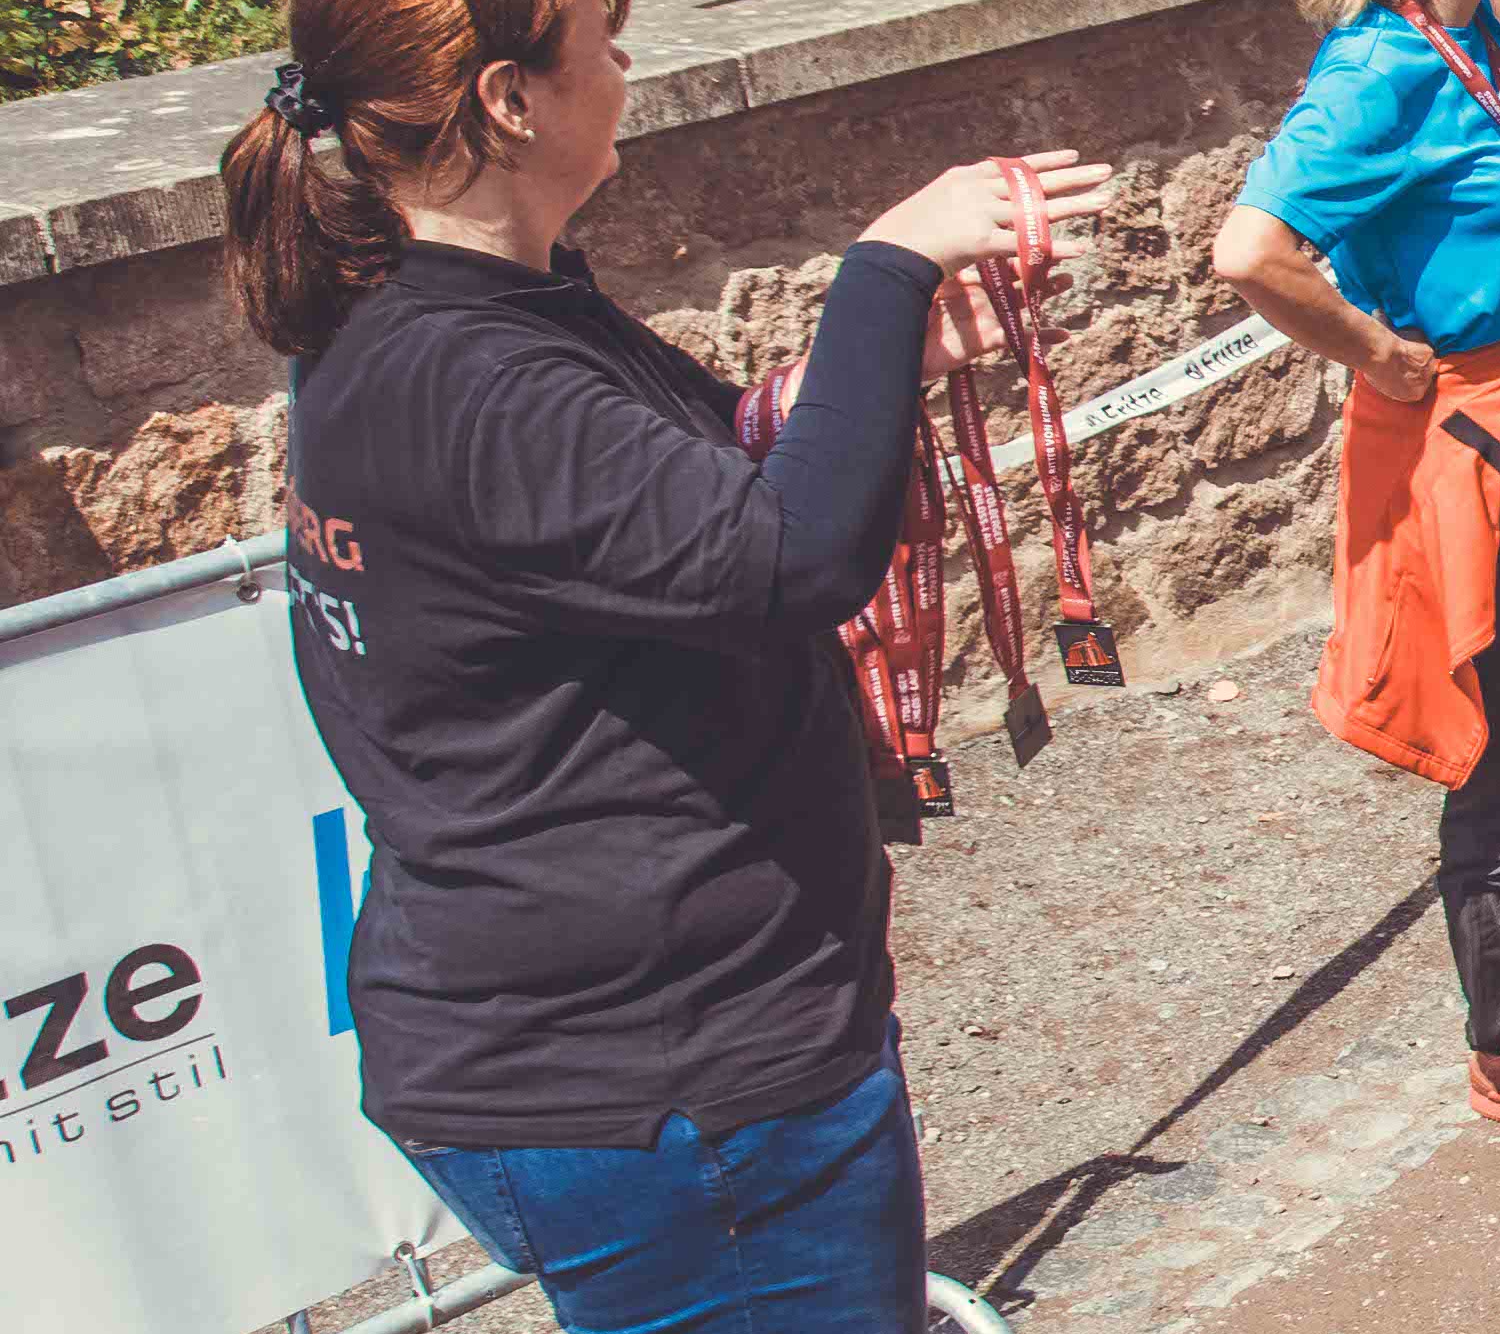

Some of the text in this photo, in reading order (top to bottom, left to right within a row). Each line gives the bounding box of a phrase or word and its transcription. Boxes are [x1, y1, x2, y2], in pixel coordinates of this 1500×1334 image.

[1037, 384, 1057, 474] RITTER VON KEMPSKI
[0, 943, 202, 1101] ze
[107, 1045, 226, 1122] stil
